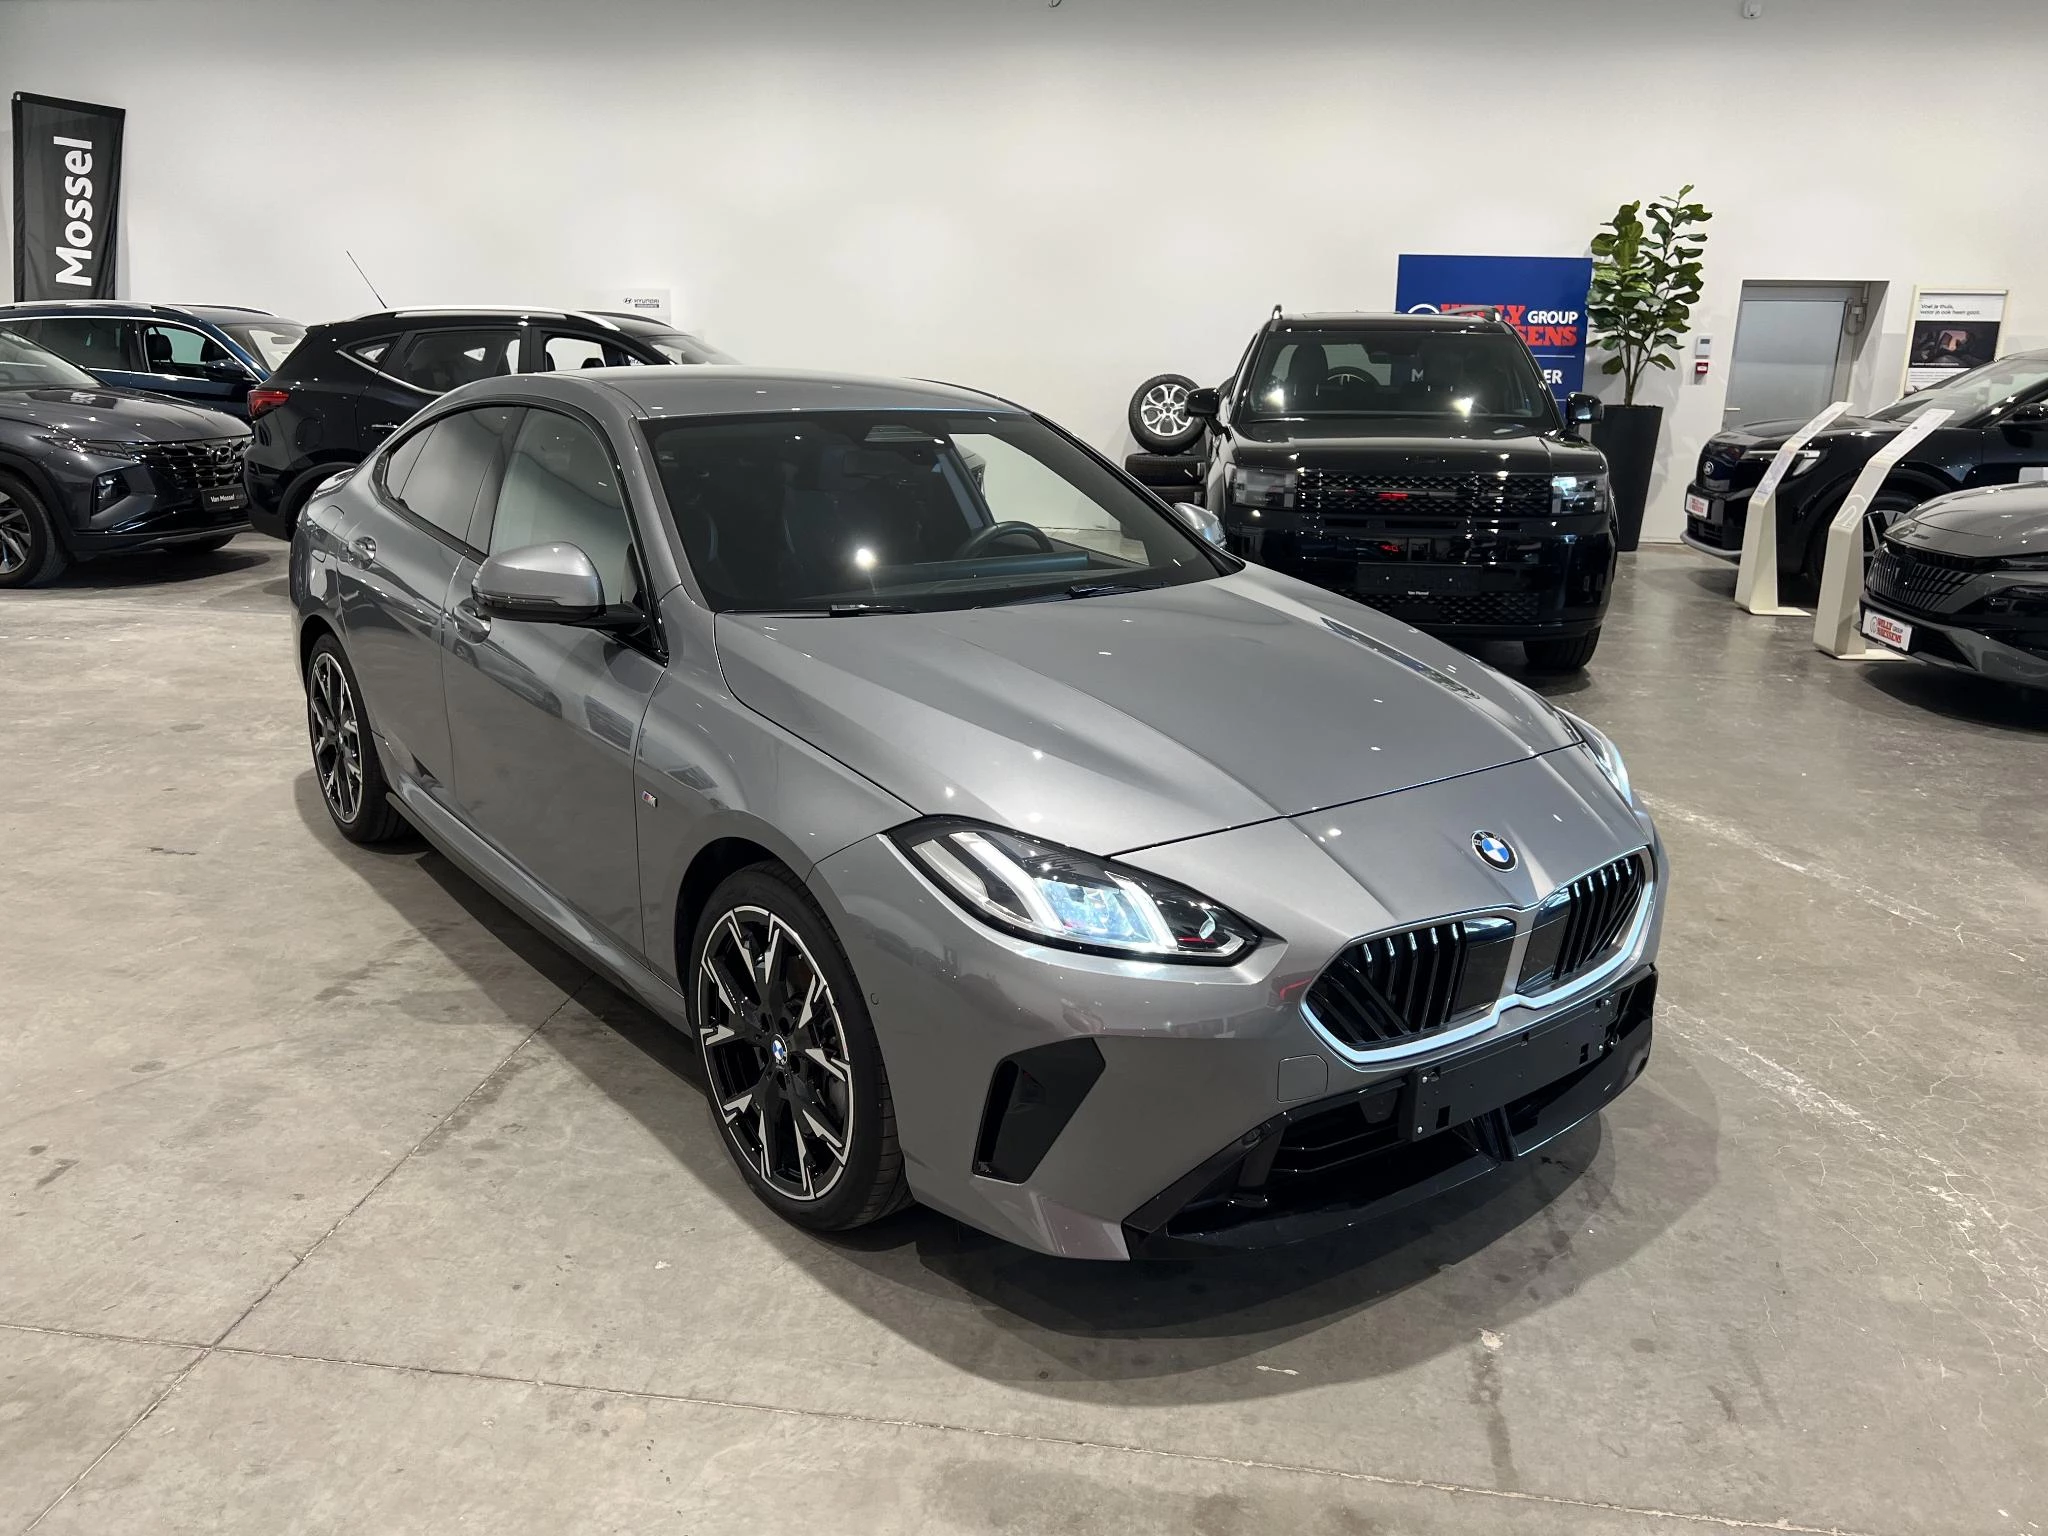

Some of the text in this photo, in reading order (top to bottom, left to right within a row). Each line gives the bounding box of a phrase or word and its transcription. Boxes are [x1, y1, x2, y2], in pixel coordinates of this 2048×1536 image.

[53, 136, 93, 286] Mossel
[1527, 310, 1579, 324] GROUP
[1543, 369, 1563, 384] ER
[220, 493, 235, 501] Mossel
